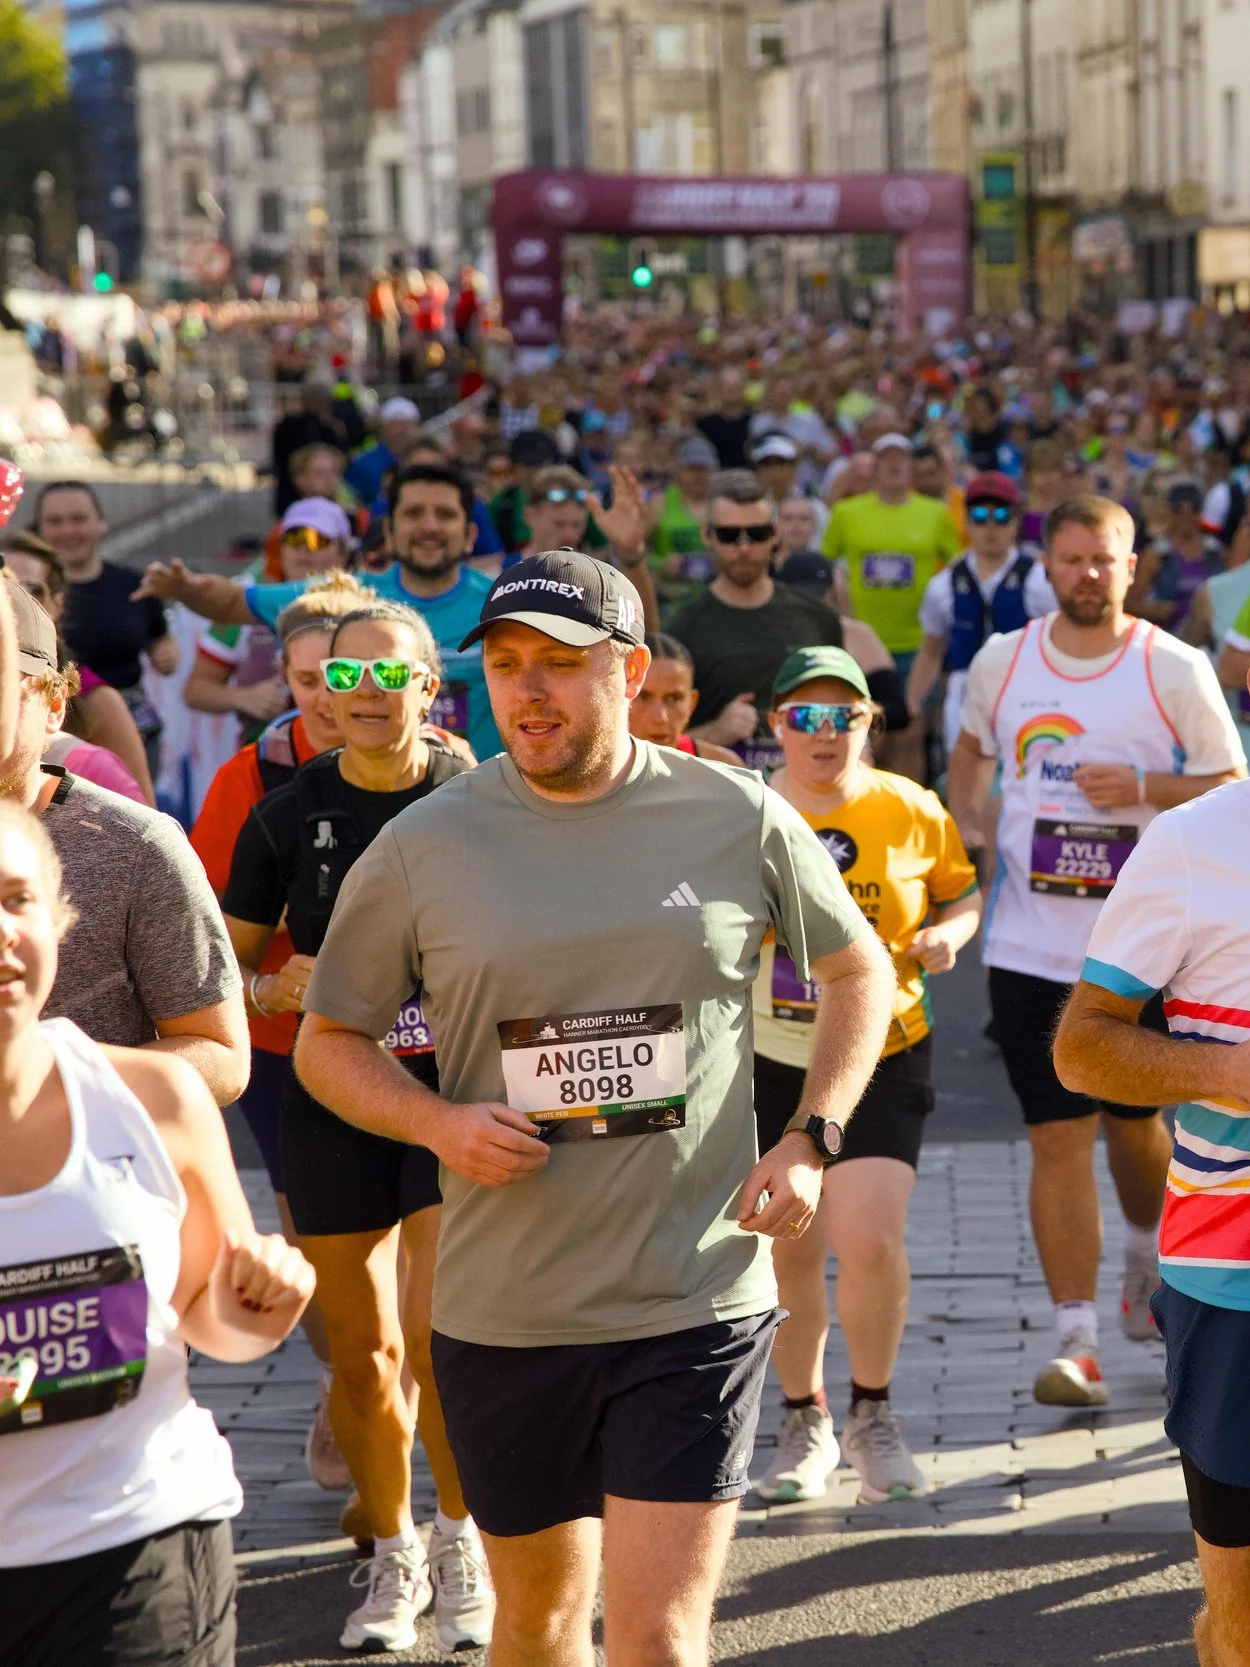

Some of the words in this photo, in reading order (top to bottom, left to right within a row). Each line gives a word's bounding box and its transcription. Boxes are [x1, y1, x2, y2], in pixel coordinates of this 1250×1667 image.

[491, 578, 584, 601] MONTIREX
[1062, 841, 1108, 860] KYLE
[1055, 857, 1112, 879] 22229
[562, 1015, 613, 1030] CARDIFF
[615, 1012, 647, 1026] HALF
[563, 1030, 587, 1038] HANNER
[587, 1027, 618, 1036] MARATHON
[536, 1042, 654, 1077] ANGELO
[559, 1074, 634, 1105] 8098
[535, 1111, 554, 1119] WHITE
[622, 1103, 645, 1111] UNISEX
[646, 1100, 668, 1108] SMALL
[55, 1255, 99, 1278] HALF
